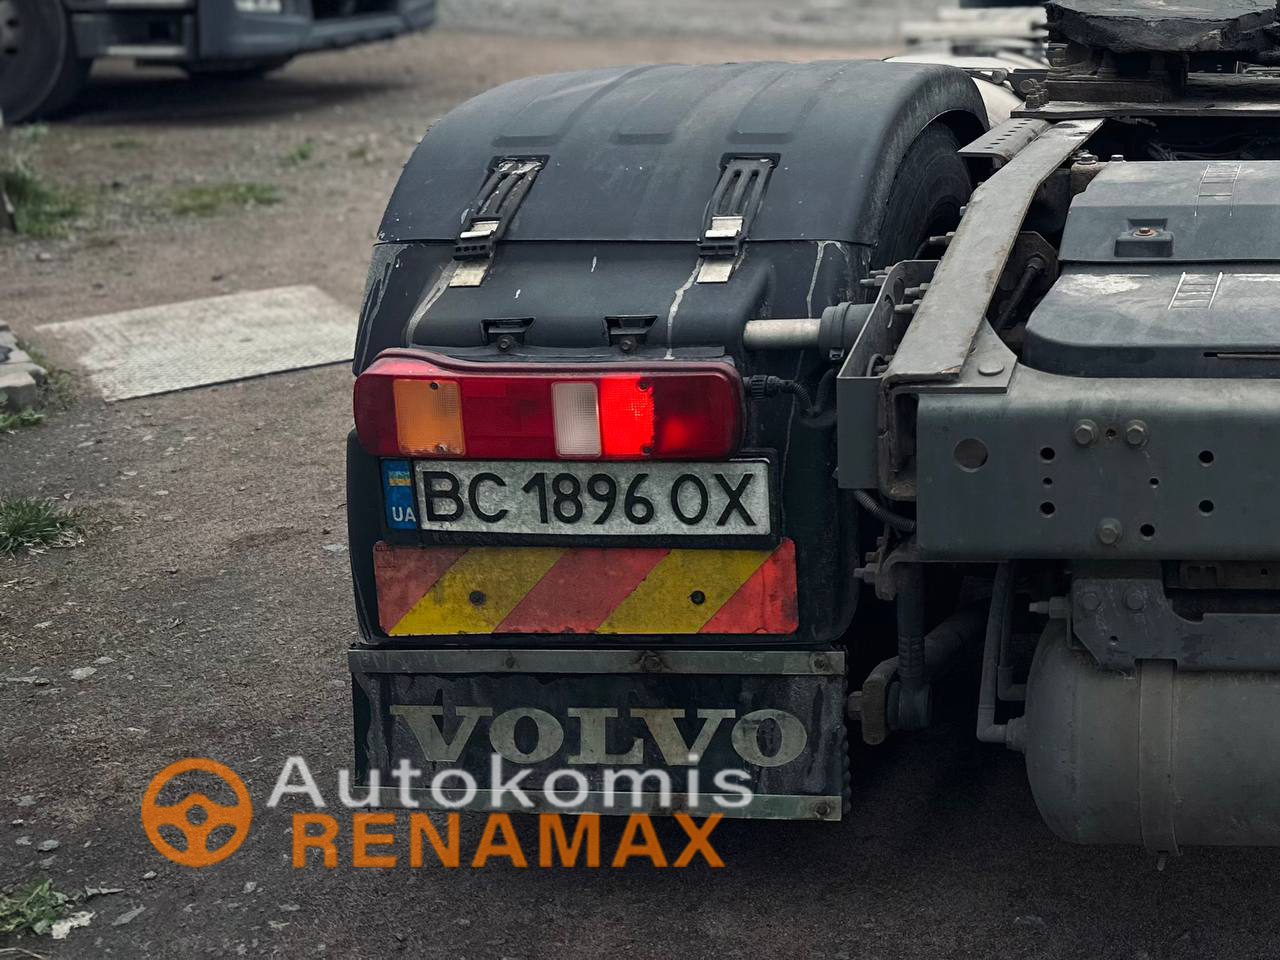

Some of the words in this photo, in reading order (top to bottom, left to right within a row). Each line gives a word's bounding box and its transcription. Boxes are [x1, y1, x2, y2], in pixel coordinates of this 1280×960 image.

[391, 505, 416, 522] UA
[422, 471, 507, 523] BC
[521, 472, 655, 525] 1896
[670, 473, 757, 526] OX
[389, 704, 808, 768] VOLVO
